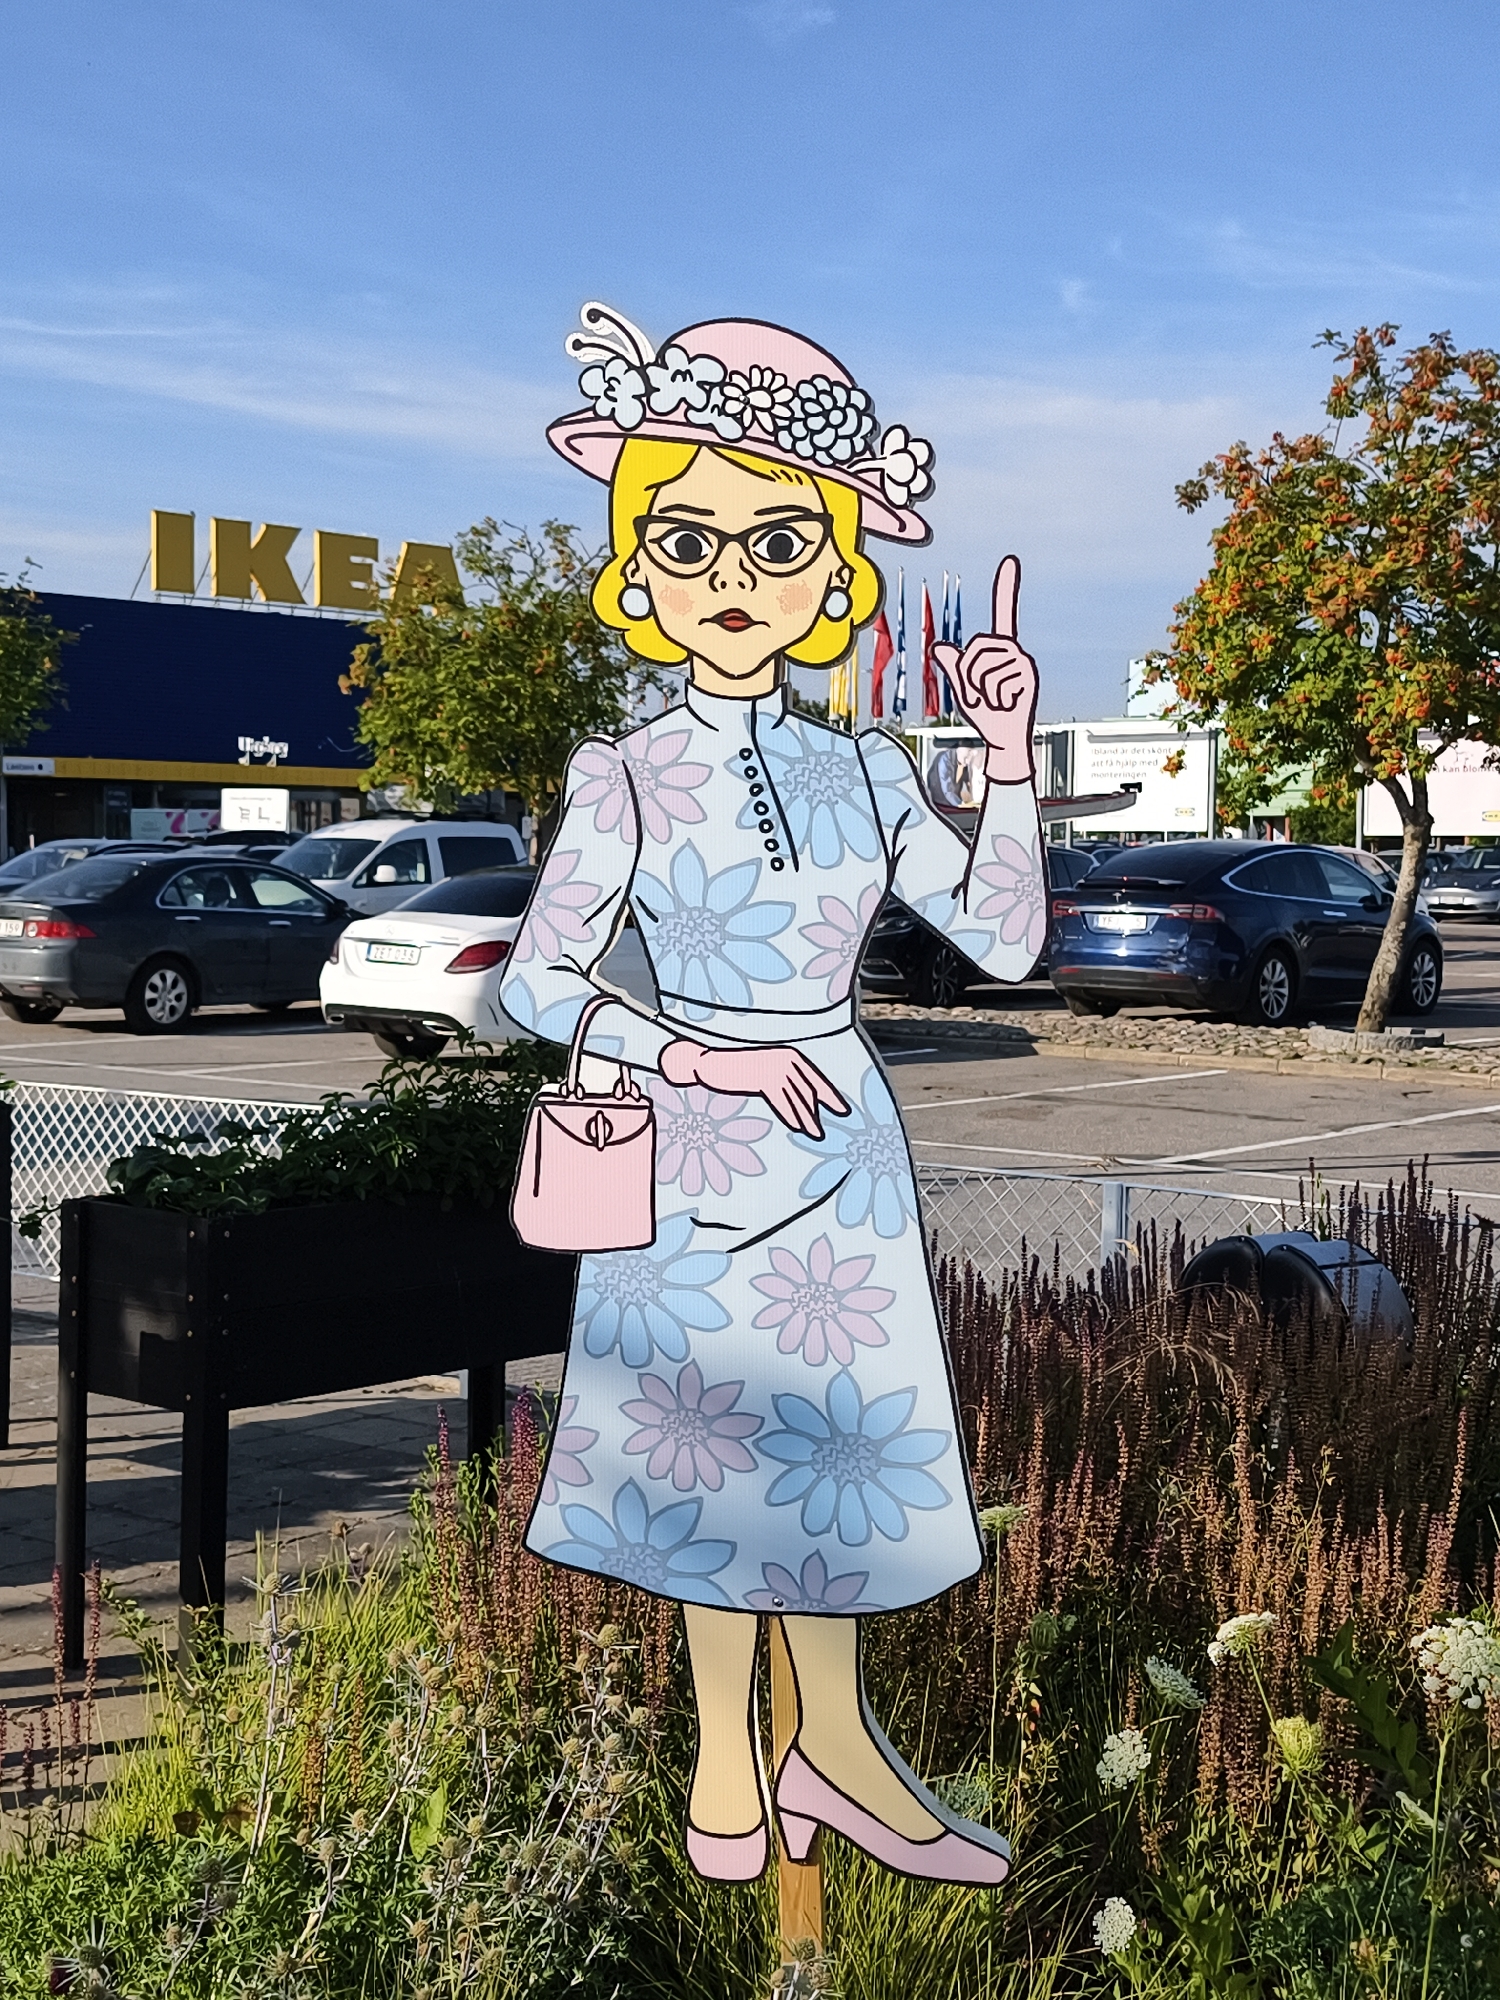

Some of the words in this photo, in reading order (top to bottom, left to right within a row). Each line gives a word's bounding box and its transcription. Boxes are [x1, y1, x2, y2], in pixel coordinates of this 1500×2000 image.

[151, 509, 466, 613] IKEA
[1091, 747, 1118, 755] Ibland
[1120, 747, 1129, 755] är
[1130, 747, 1145, 755] det
[1148, 747, 1172, 755] skönt
[1105, 759, 1114, 767] få
[1115, 759, 1138, 769] hjälp
[1139, 759, 1158, 767] med
[1443, 765, 1460, 773] kan
[1091, 771, 1147, 779] monteringen
